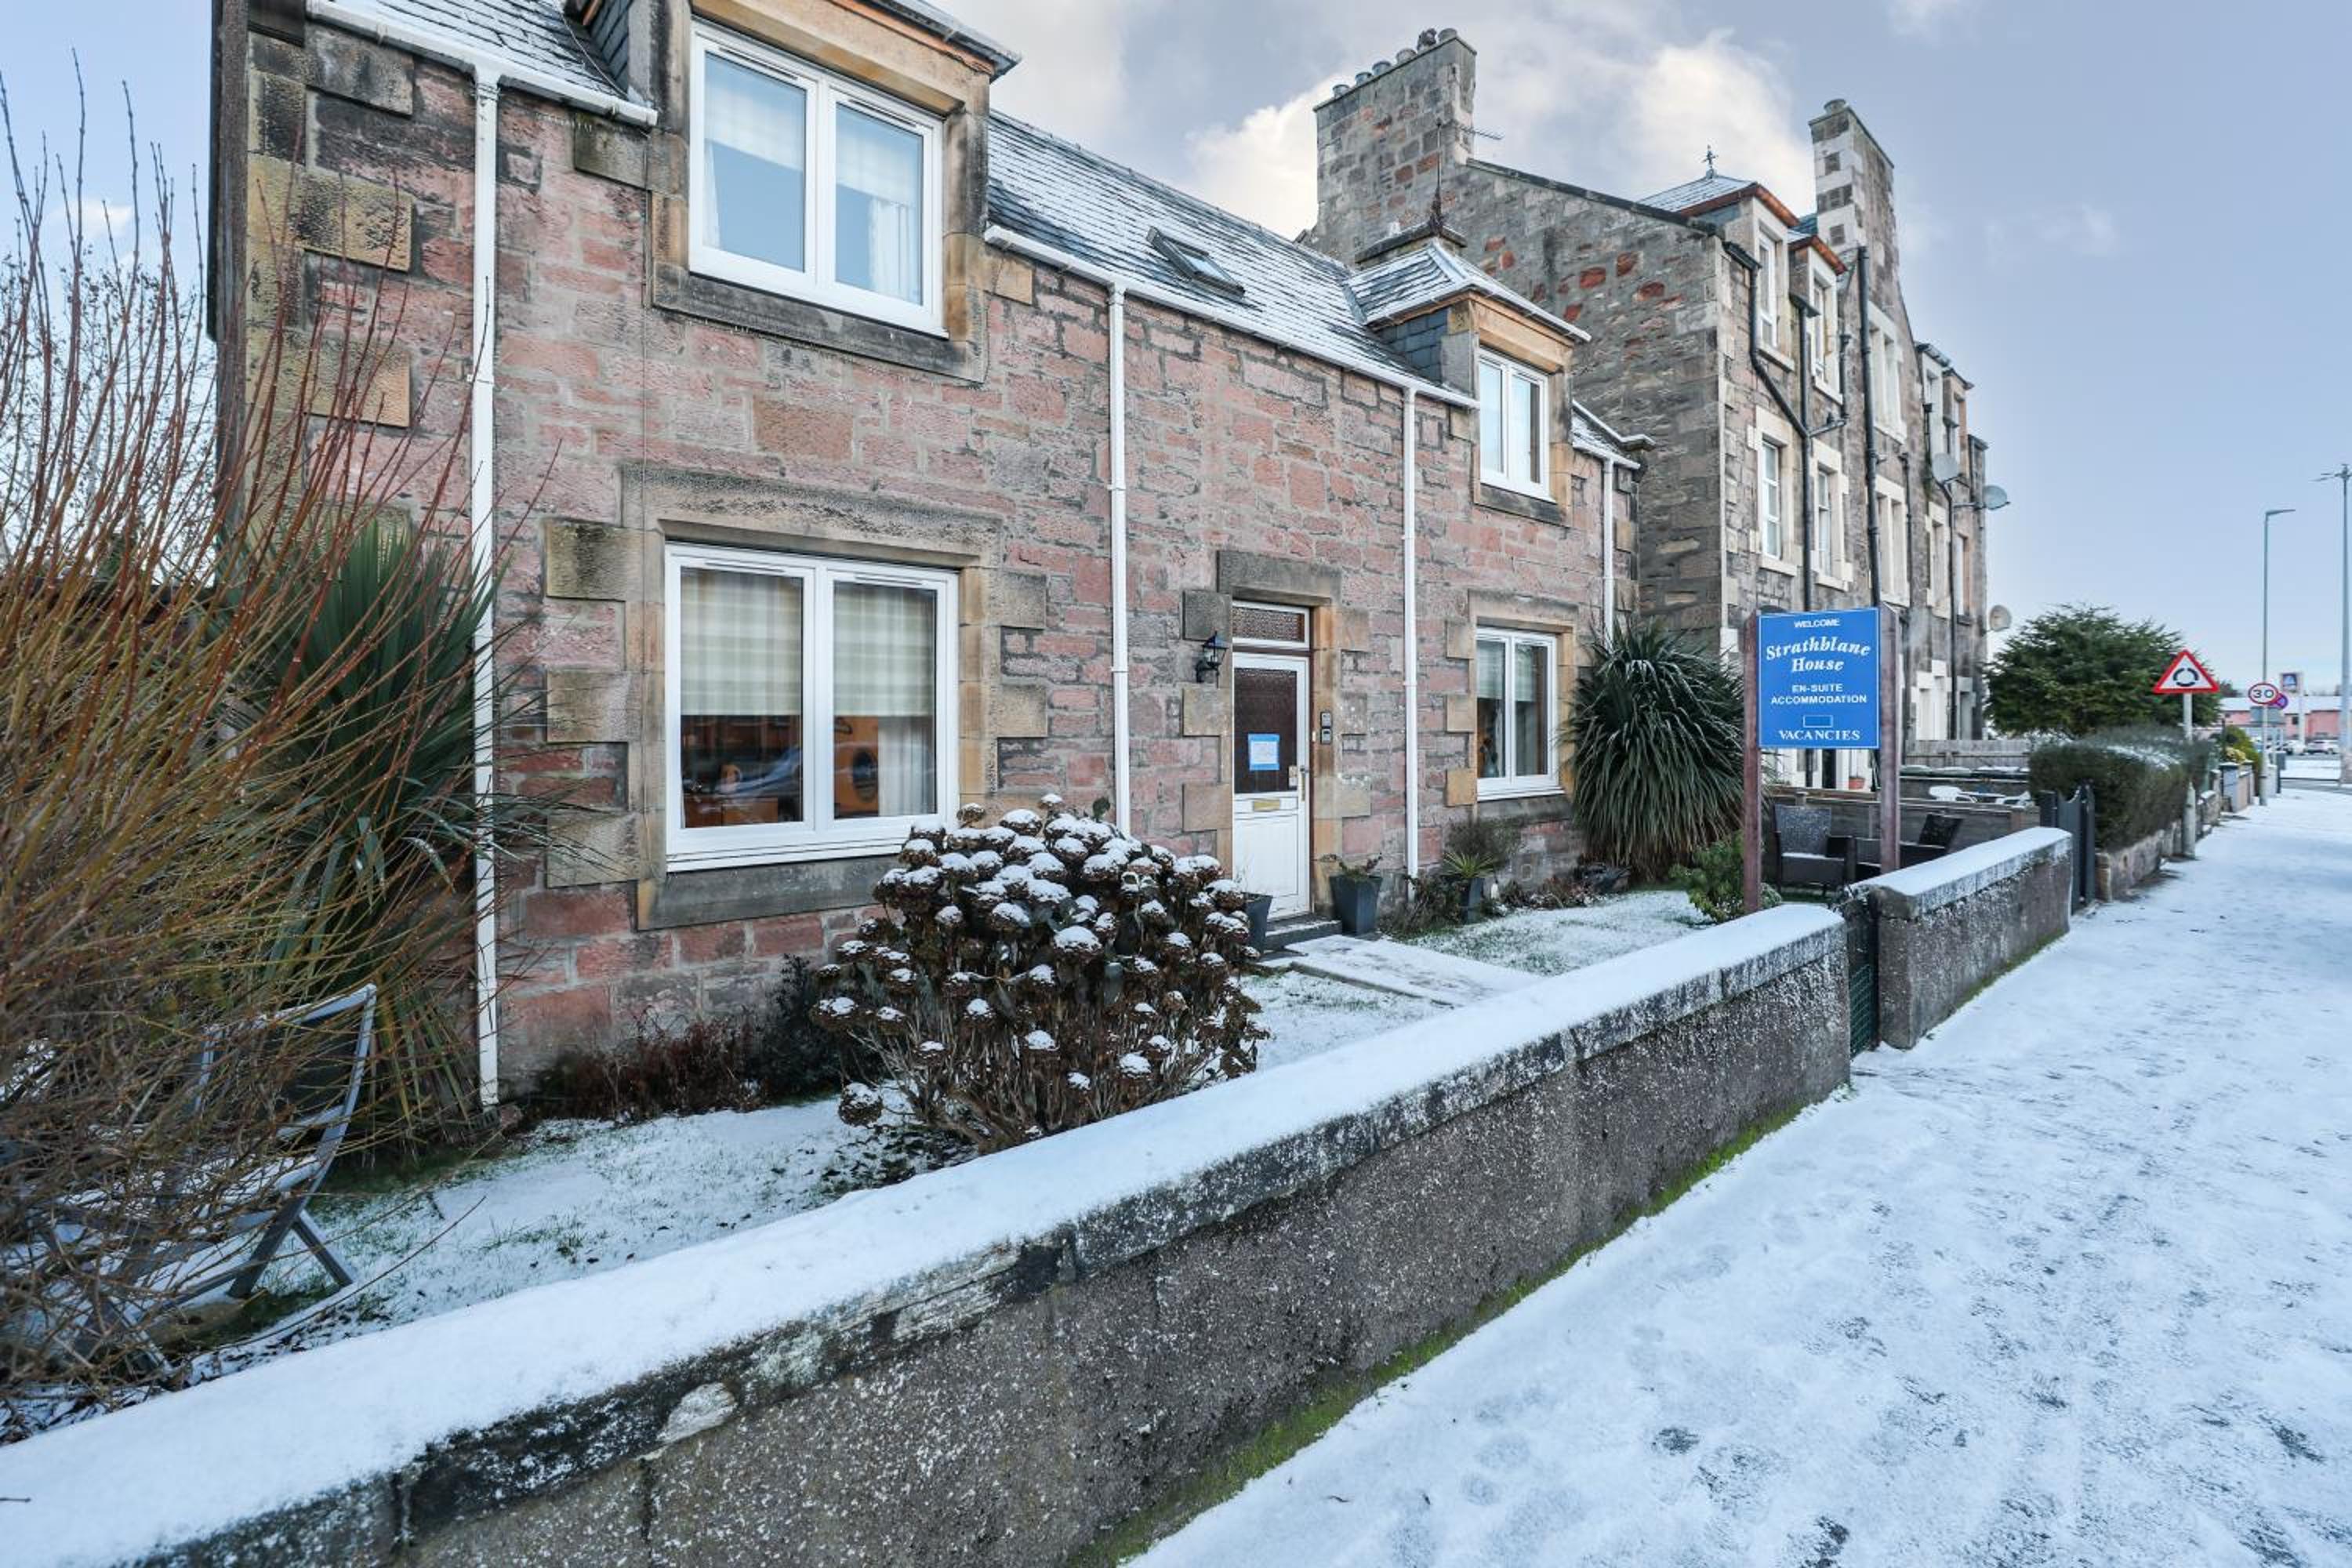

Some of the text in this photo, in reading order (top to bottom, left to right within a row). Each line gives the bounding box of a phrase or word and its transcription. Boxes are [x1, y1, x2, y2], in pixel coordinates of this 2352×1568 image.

[1794, 619, 1840, 627] WELCOME
[1766, 636, 1871, 661] Strathblane
[1791, 657, 1845, 673] House
[1791, 684, 1843, 694] EN-SUITE
[2252, 689, 2274, 699] 30
[1771, 695, 1867, 705] ACCOMMODATION
[1779, 730, 1861, 741] VACANCIES
